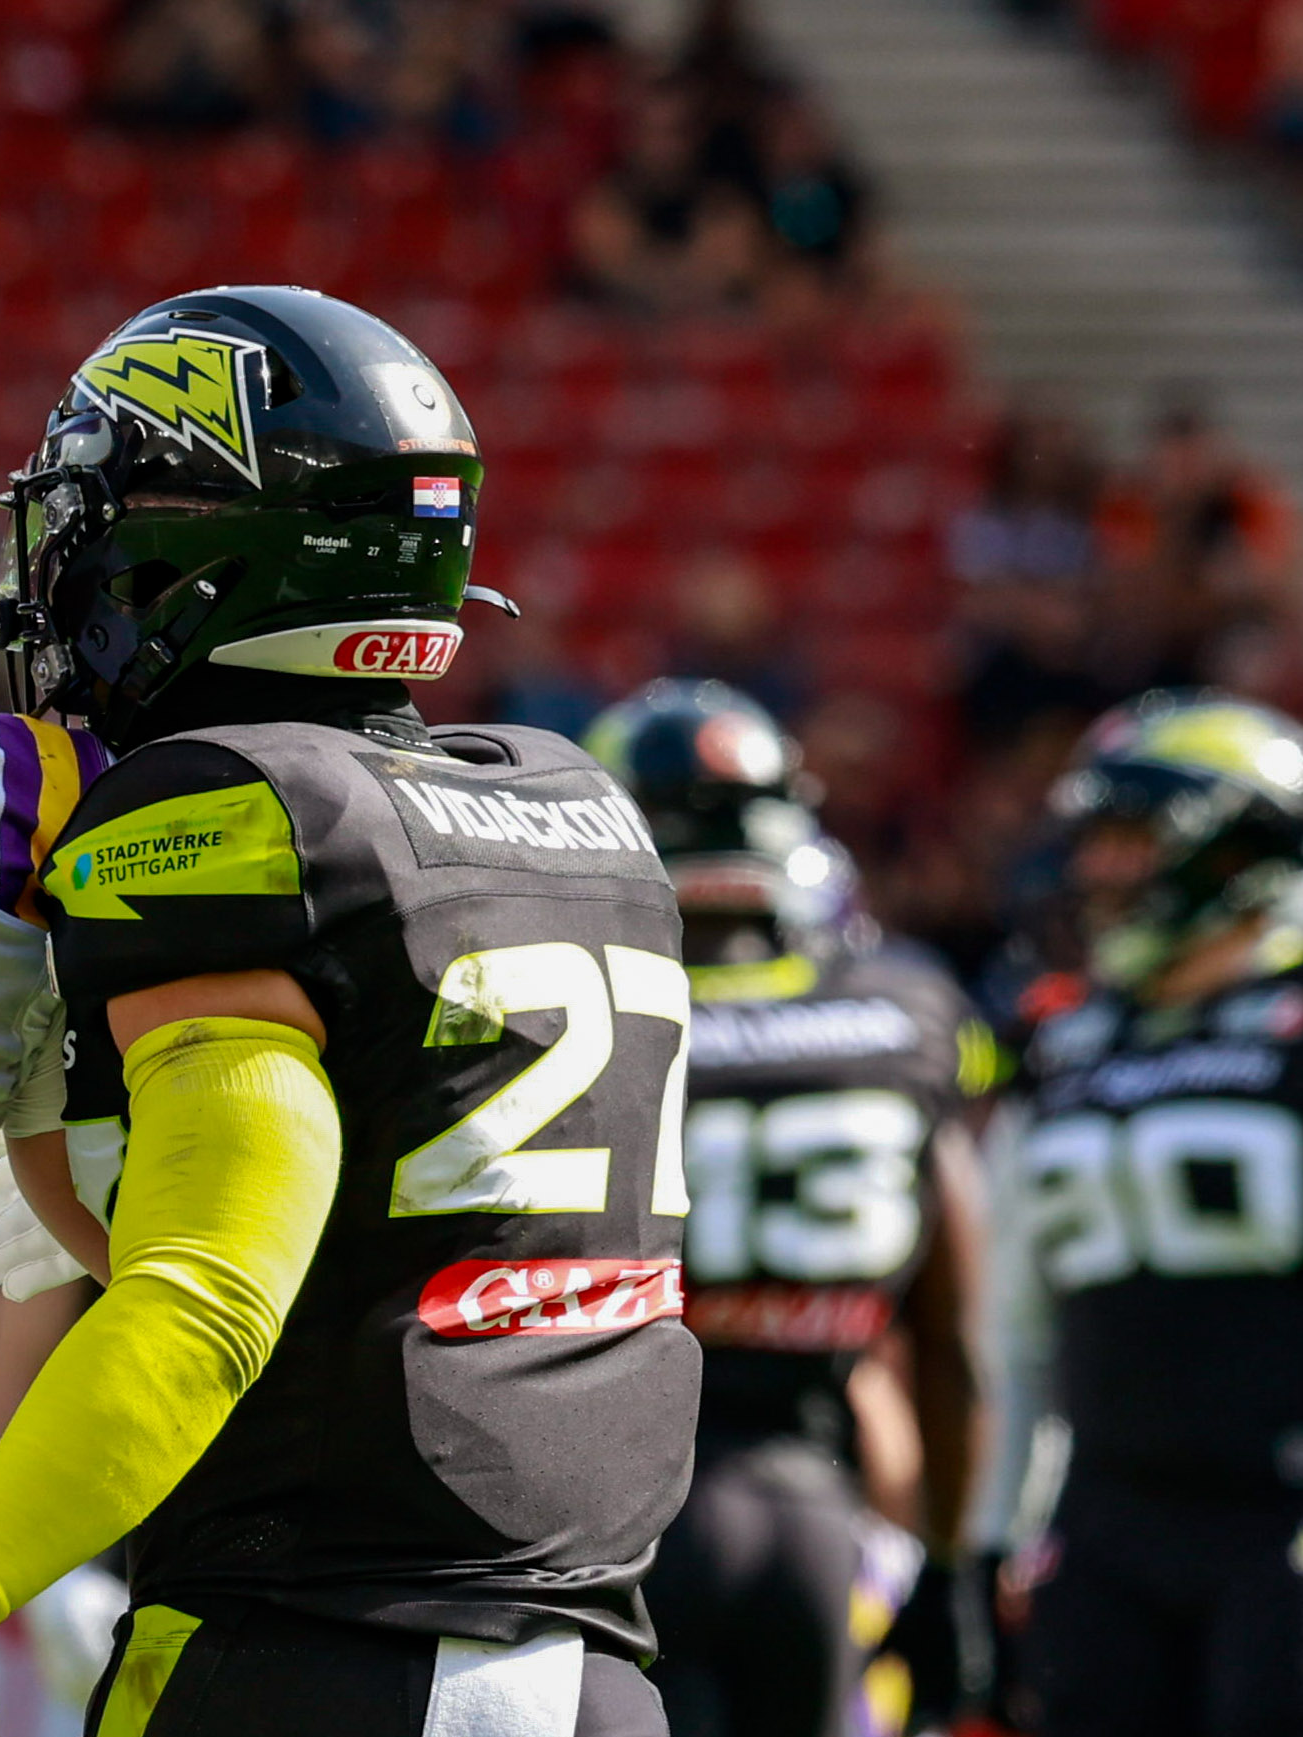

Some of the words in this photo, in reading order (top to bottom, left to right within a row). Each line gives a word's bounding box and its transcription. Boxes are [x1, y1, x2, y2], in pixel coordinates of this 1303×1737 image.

[303, 534, 349, 549] Riddell
[367, 546, 380, 557] 27
[96, 830, 223, 866] STADTWERKE
[97, 853, 201, 887] STUTTGART
[388, 941, 691, 1219] 27
